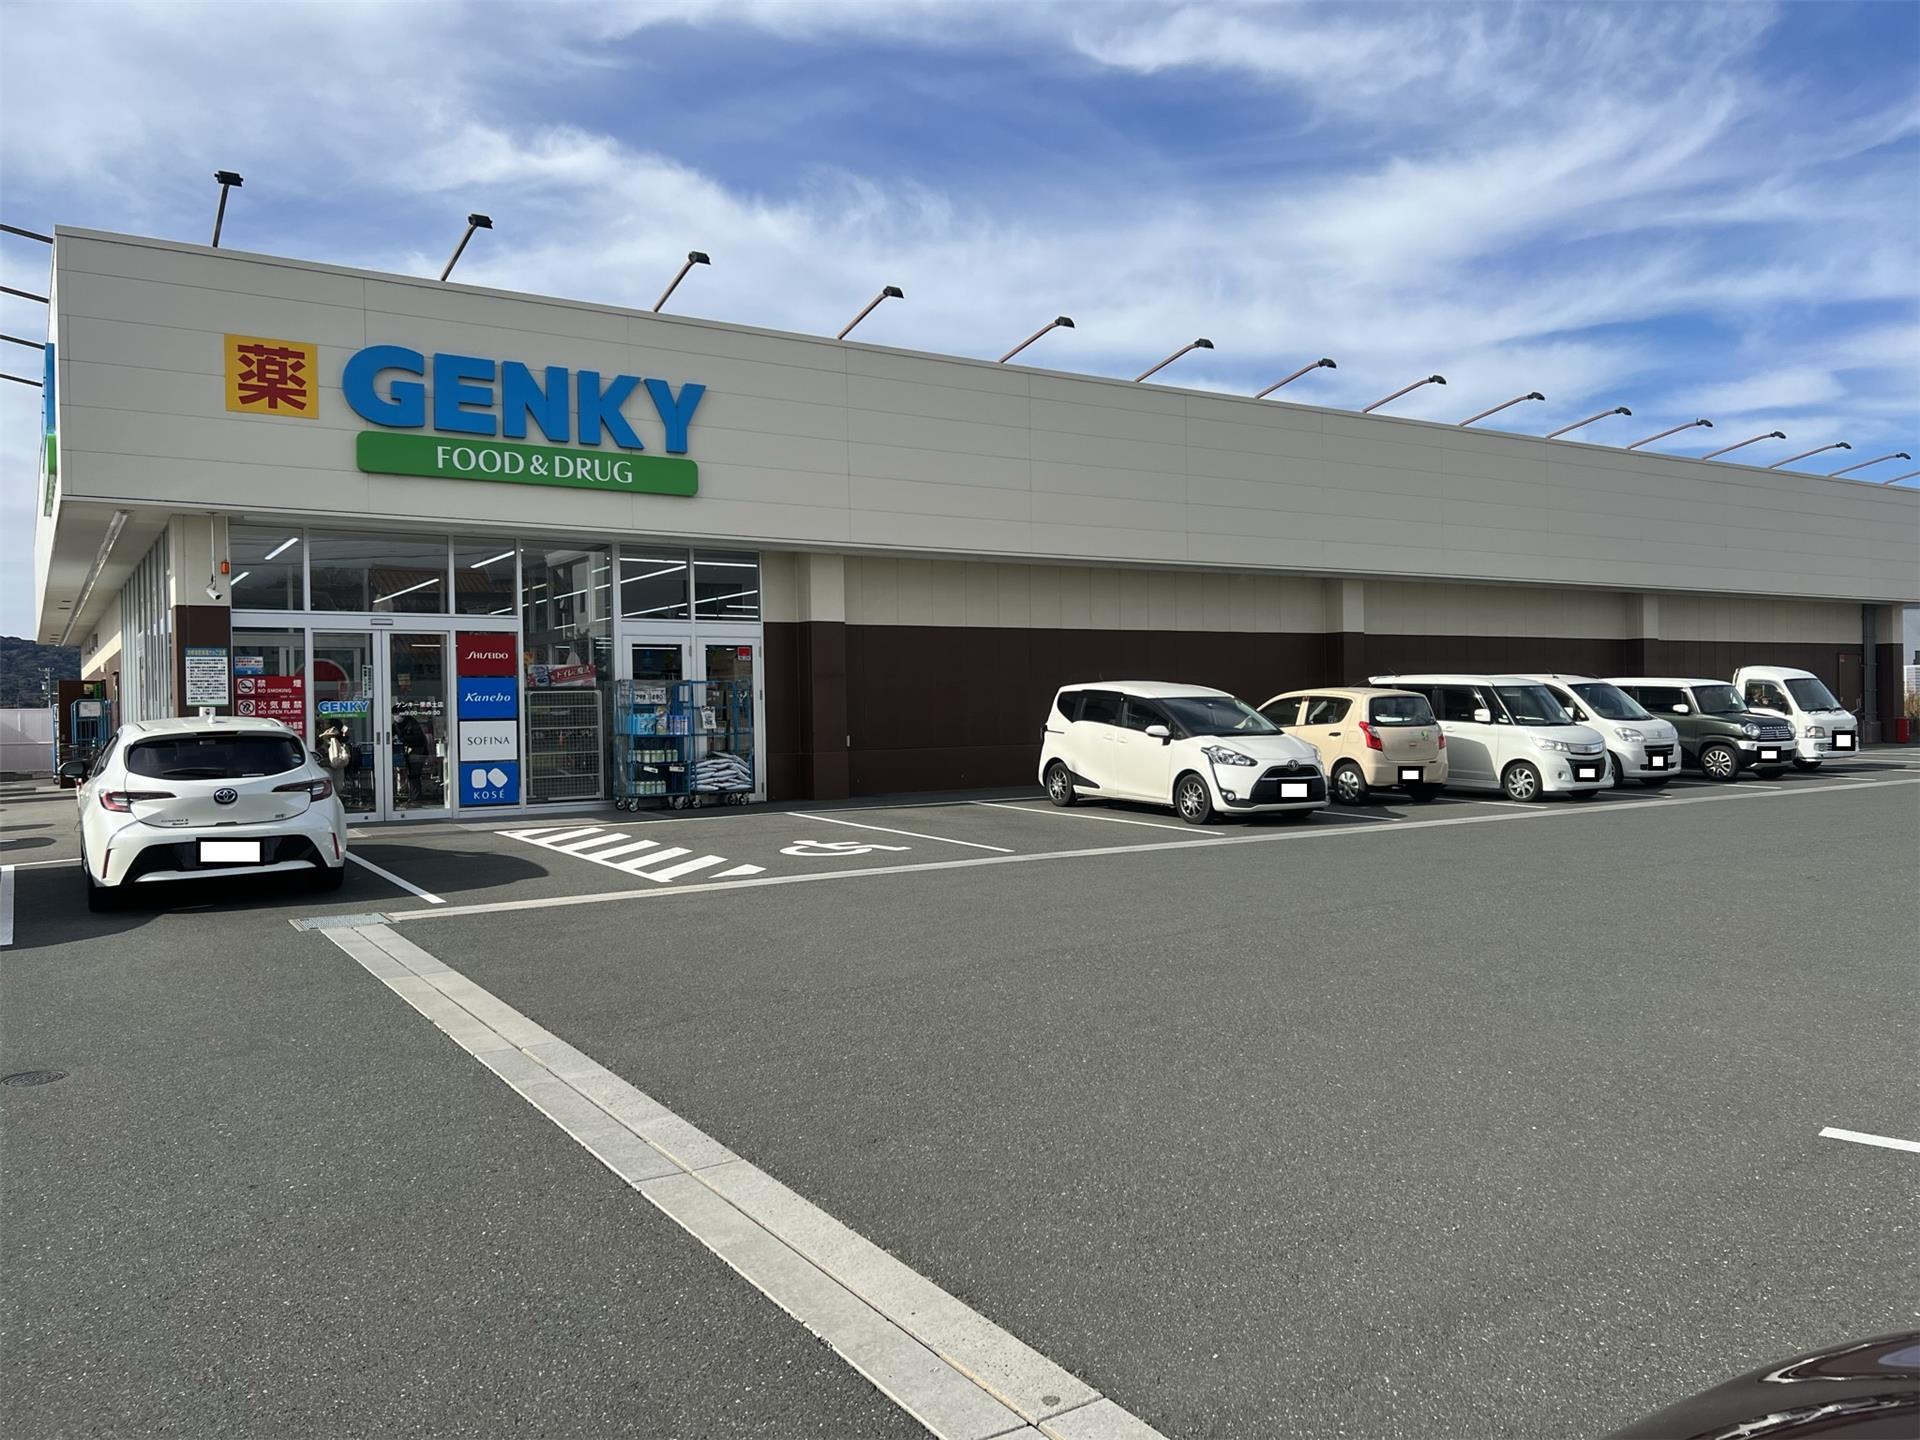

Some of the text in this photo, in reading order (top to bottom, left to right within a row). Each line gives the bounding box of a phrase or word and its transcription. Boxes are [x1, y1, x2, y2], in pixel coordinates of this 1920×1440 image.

[237, 344, 306, 410] 薬
[342, 344, 706, 454] GENKY
[436, 446, 525, 475] FOOD
[554, 456, 633, 483] DRUG
[465, 651, 509, 660] SHISEIDO
[465, 692, 511, 702] Kanebo
[258, 701, 302, 709] 火気厳禁
[318, 701, 369, 713] GENKY
[467, 736, 510, 746] SOFINA
[473, 788, 505, 800] KOSÉ
